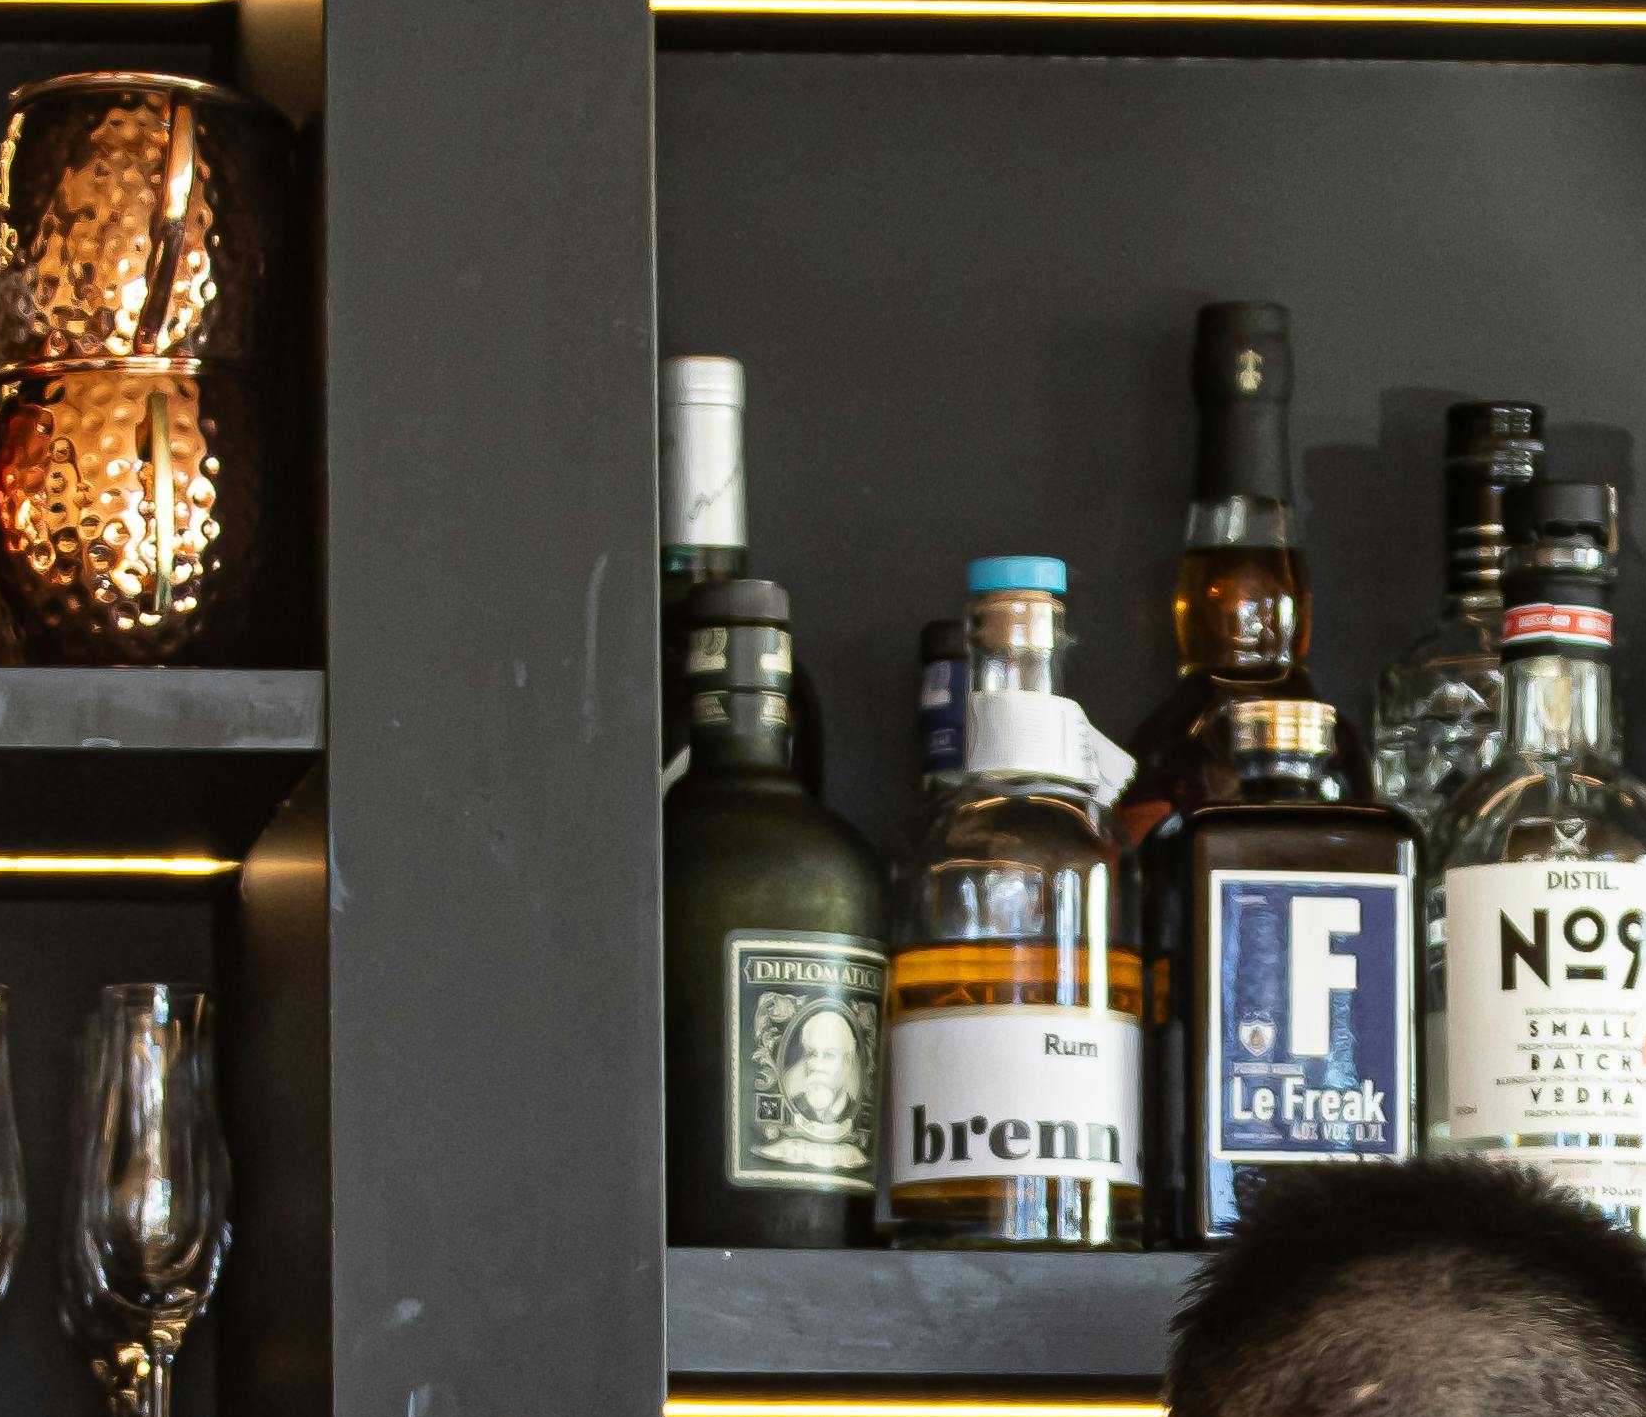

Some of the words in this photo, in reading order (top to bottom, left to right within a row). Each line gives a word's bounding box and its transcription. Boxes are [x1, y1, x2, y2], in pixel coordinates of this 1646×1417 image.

[1289, 897, 1361, 1057] F
[1529, 1020, 1632, 1038] SMALL
[1044, 1032, 1098, 1057] Rum
[1530, 1053, 1632, 1072] BATCH
[1233, 1077, 1275, 1120] Le
[1284, 1077, 1386, 1122] Freak
[1529, 1087, 1634, 1105] VODKA
